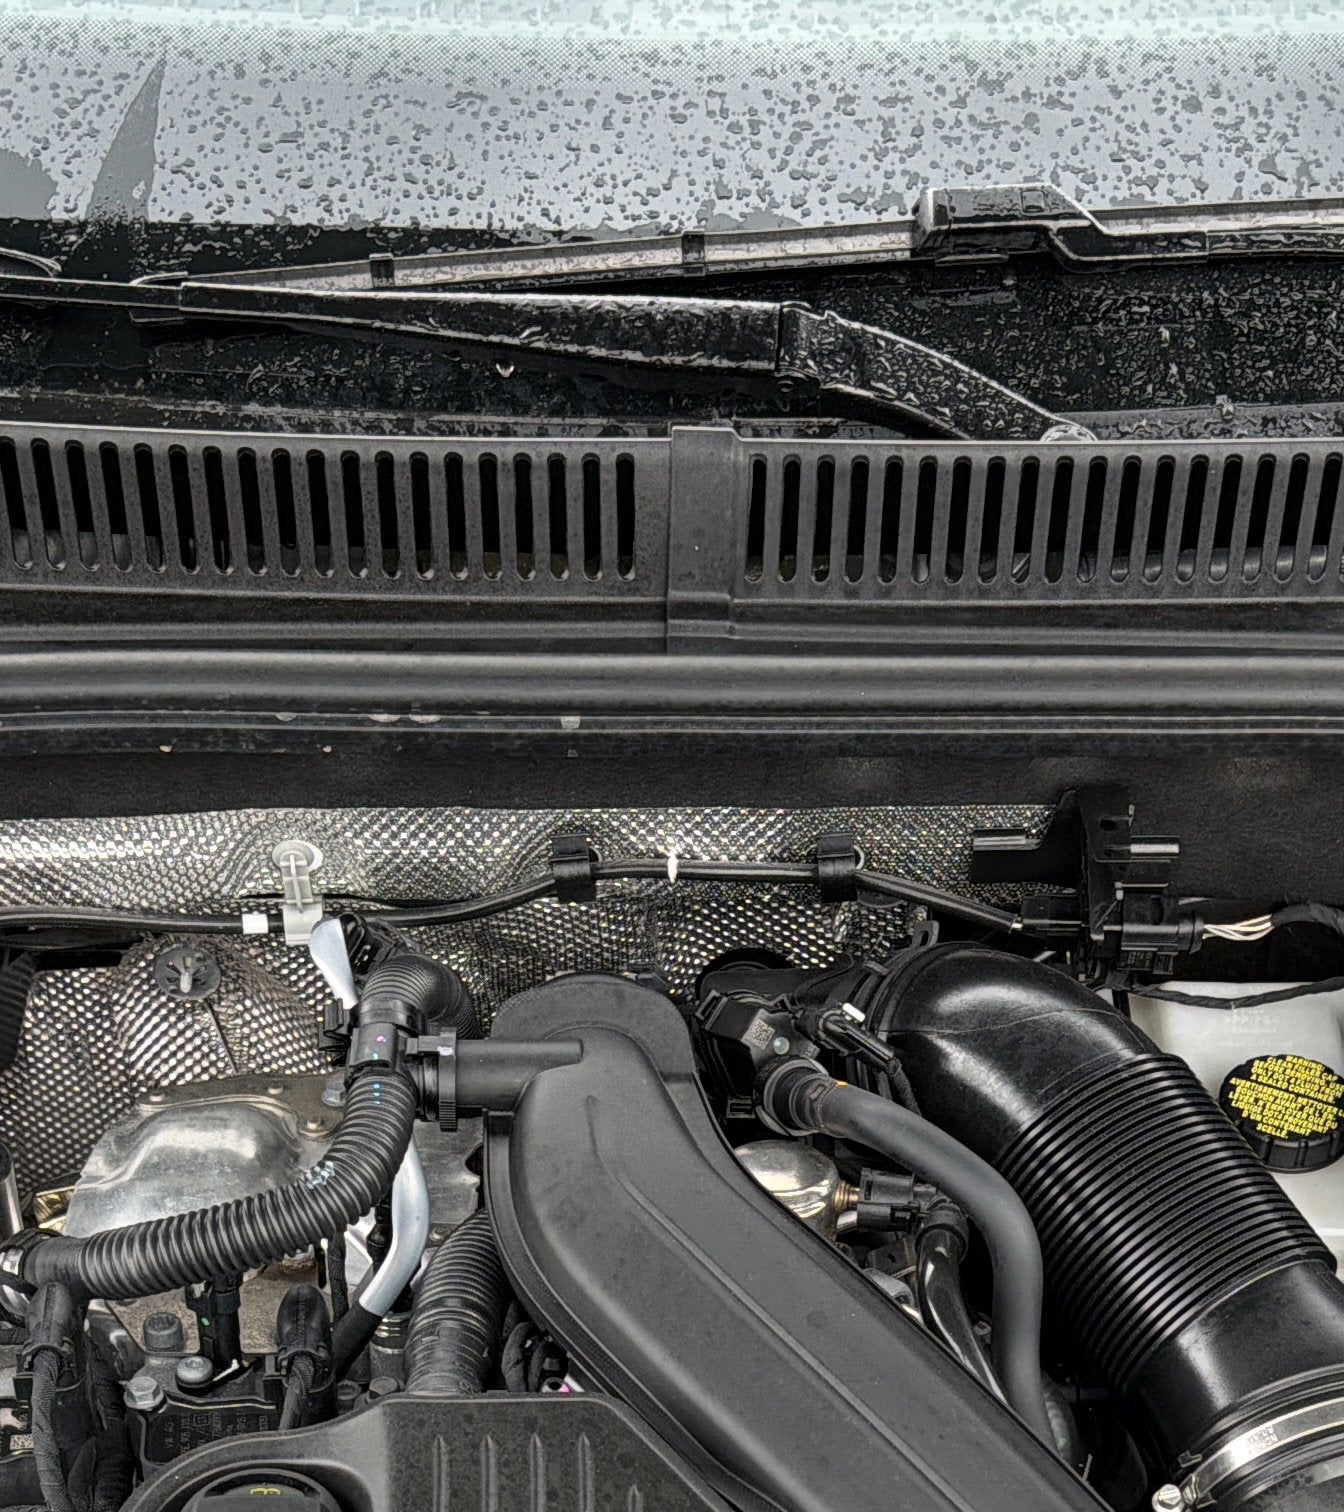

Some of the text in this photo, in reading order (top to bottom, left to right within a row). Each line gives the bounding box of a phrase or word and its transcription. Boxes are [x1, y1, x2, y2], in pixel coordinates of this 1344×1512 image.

[1250, 1066, 1271, 1077] ONLY
[1272, 1072, 1289, 1082] DOT
[1295, 1079, 1319, 1091] FLUID
[1319, 1086, 1342, 1098] FROM
[1252, 1059, 1284, 1073] BEFORE
[1328, 1082, 1344, 1091] USE
[1257, 1075, 1288, 1089] SEALED
[1266, 1056, 1338, 1082] CLEAN FILLER CAP
